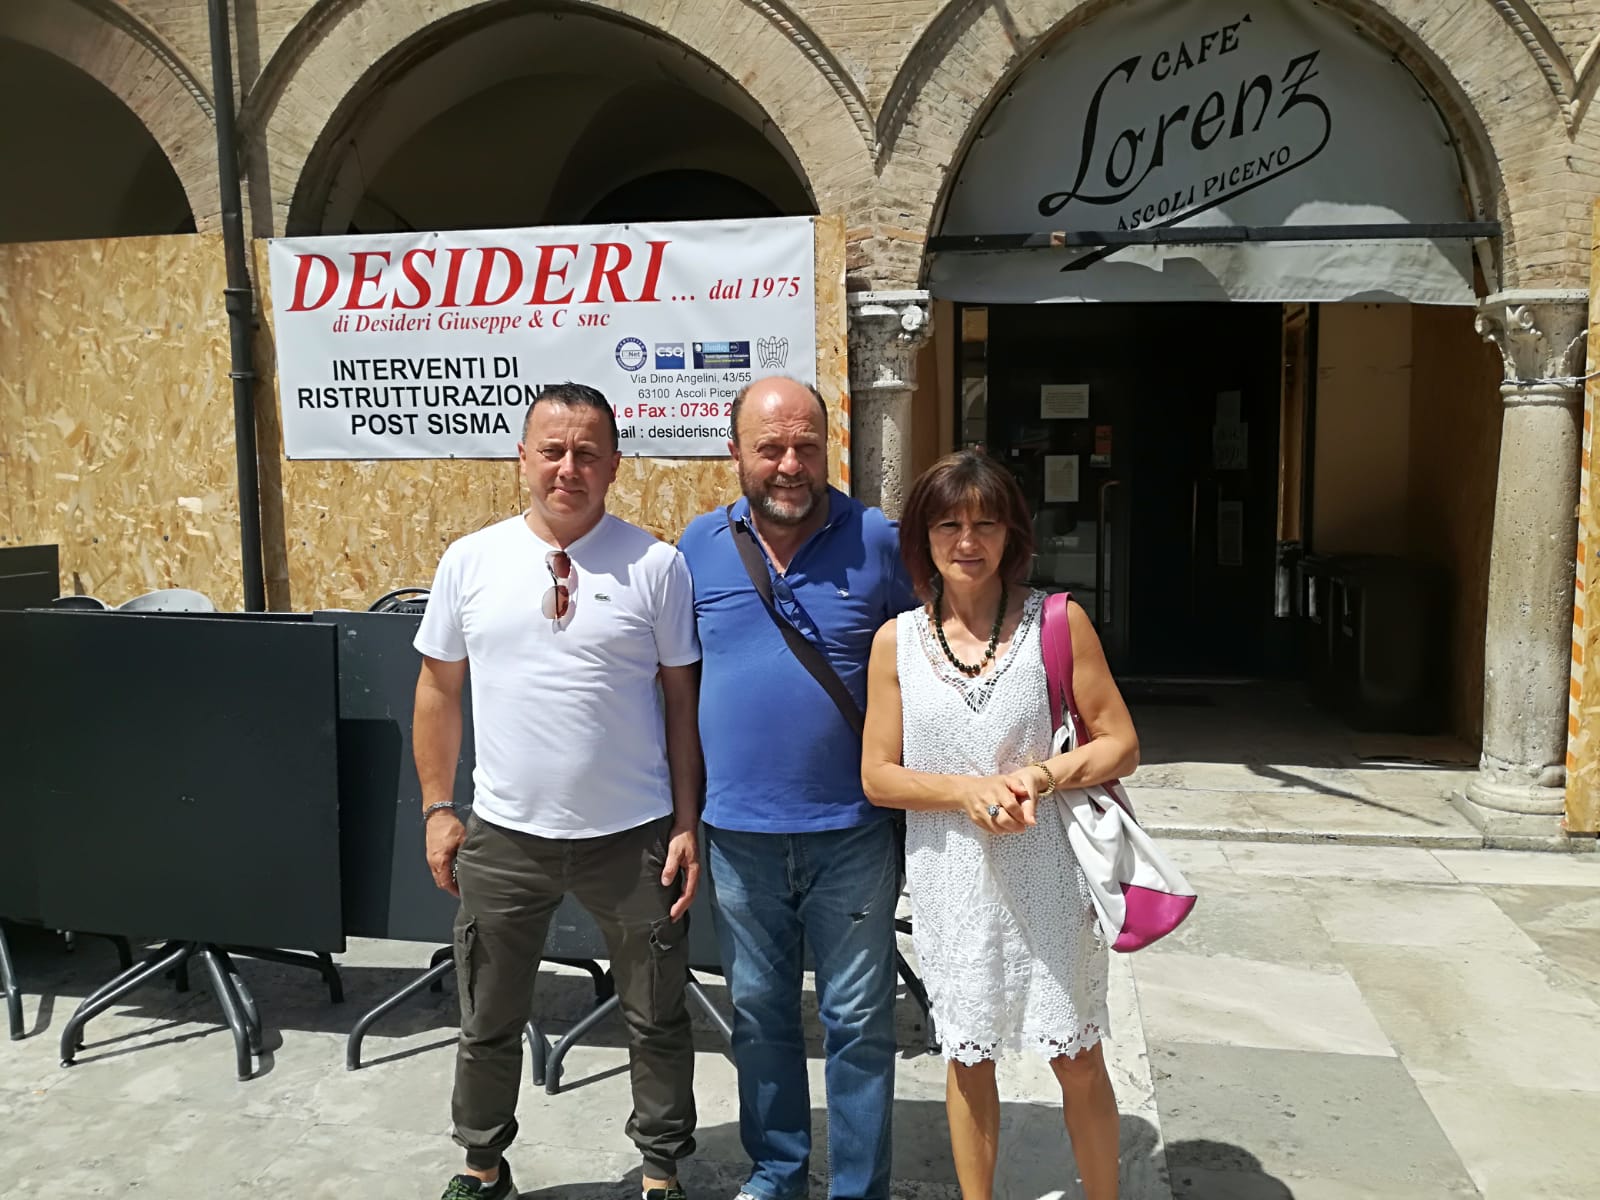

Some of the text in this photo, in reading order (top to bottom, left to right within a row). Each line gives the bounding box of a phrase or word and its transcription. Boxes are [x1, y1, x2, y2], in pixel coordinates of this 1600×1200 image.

[1038, 49, 1332, 217] Lorenz
[1117, 145, 1291, 231] ASCOLI PICENO
[708, 278, 744, 301] dal
[750, 276, 801, 299] 1975
[333, 309, 611, 334] di Desideri Giuseppe & C snc
[656, 346, 684, 358] CSQ
[333, 357, 518, 382] INTERVENTI DI
[631, 372, 752, 386] Via Dino Angelini, 43/55
[298, 384, 552, 410] RISTRUTTURAZION
[638, 388, 740, 399] 63100 Ascoli Picen
[624, 408, 633, 417] e
[638, 404, 667, 418] Fax
[680, 403, 719, 417] 0736
[351, 411, 511, 436] POST SISMA
